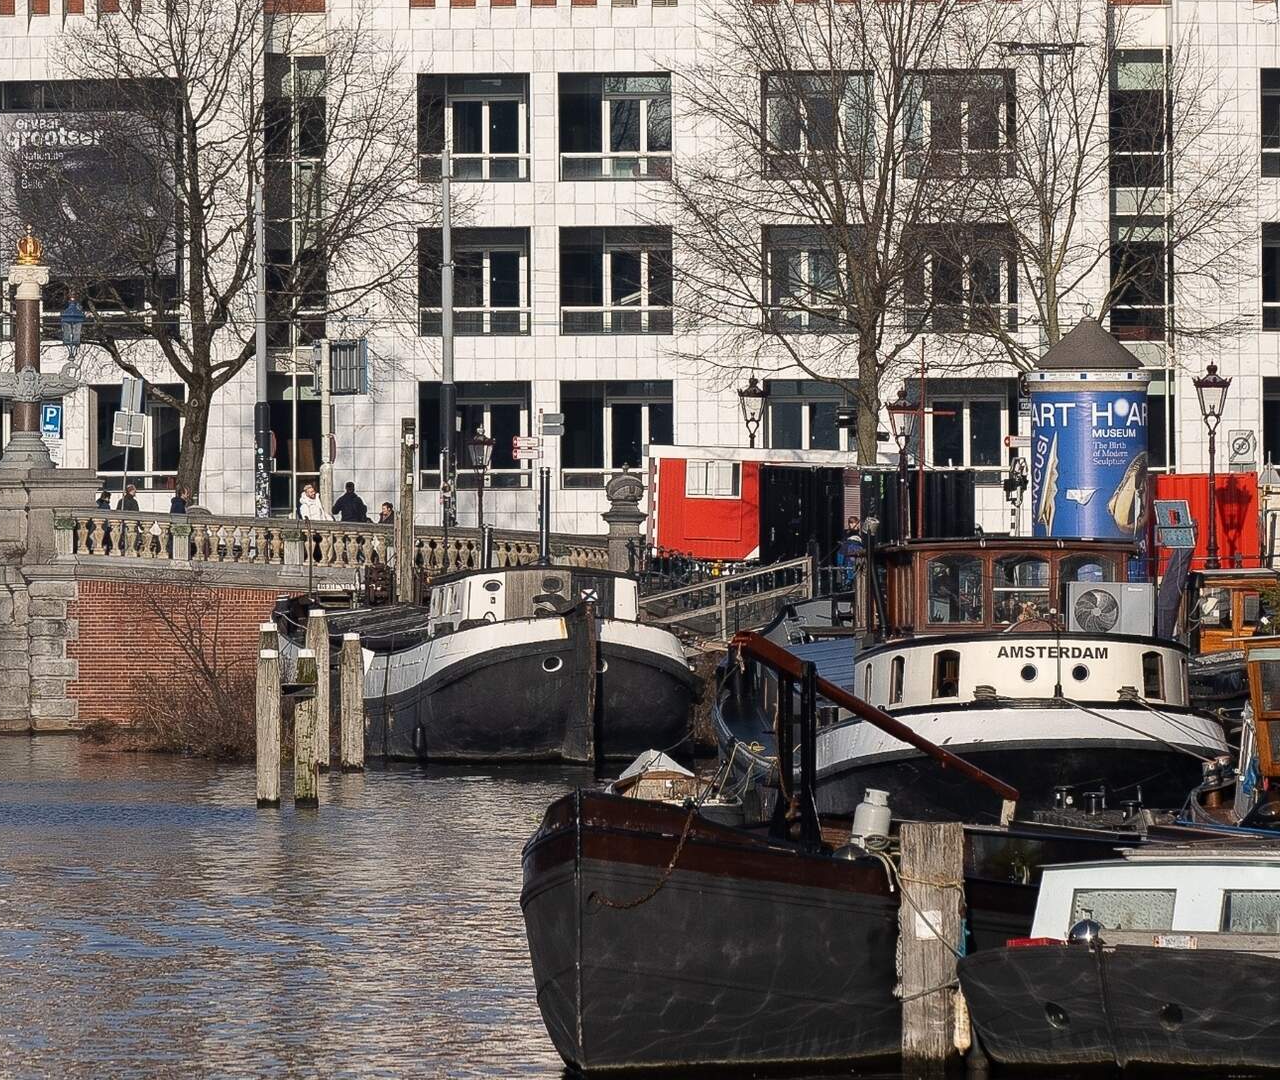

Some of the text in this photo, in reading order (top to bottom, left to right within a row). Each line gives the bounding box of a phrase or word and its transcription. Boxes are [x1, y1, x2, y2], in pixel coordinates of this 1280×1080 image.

[46, 407, 58, 423] P
[1091, 428, 1136, 438] MUSEUM
[997, 646, 1108, 659] AMSTERDAM
